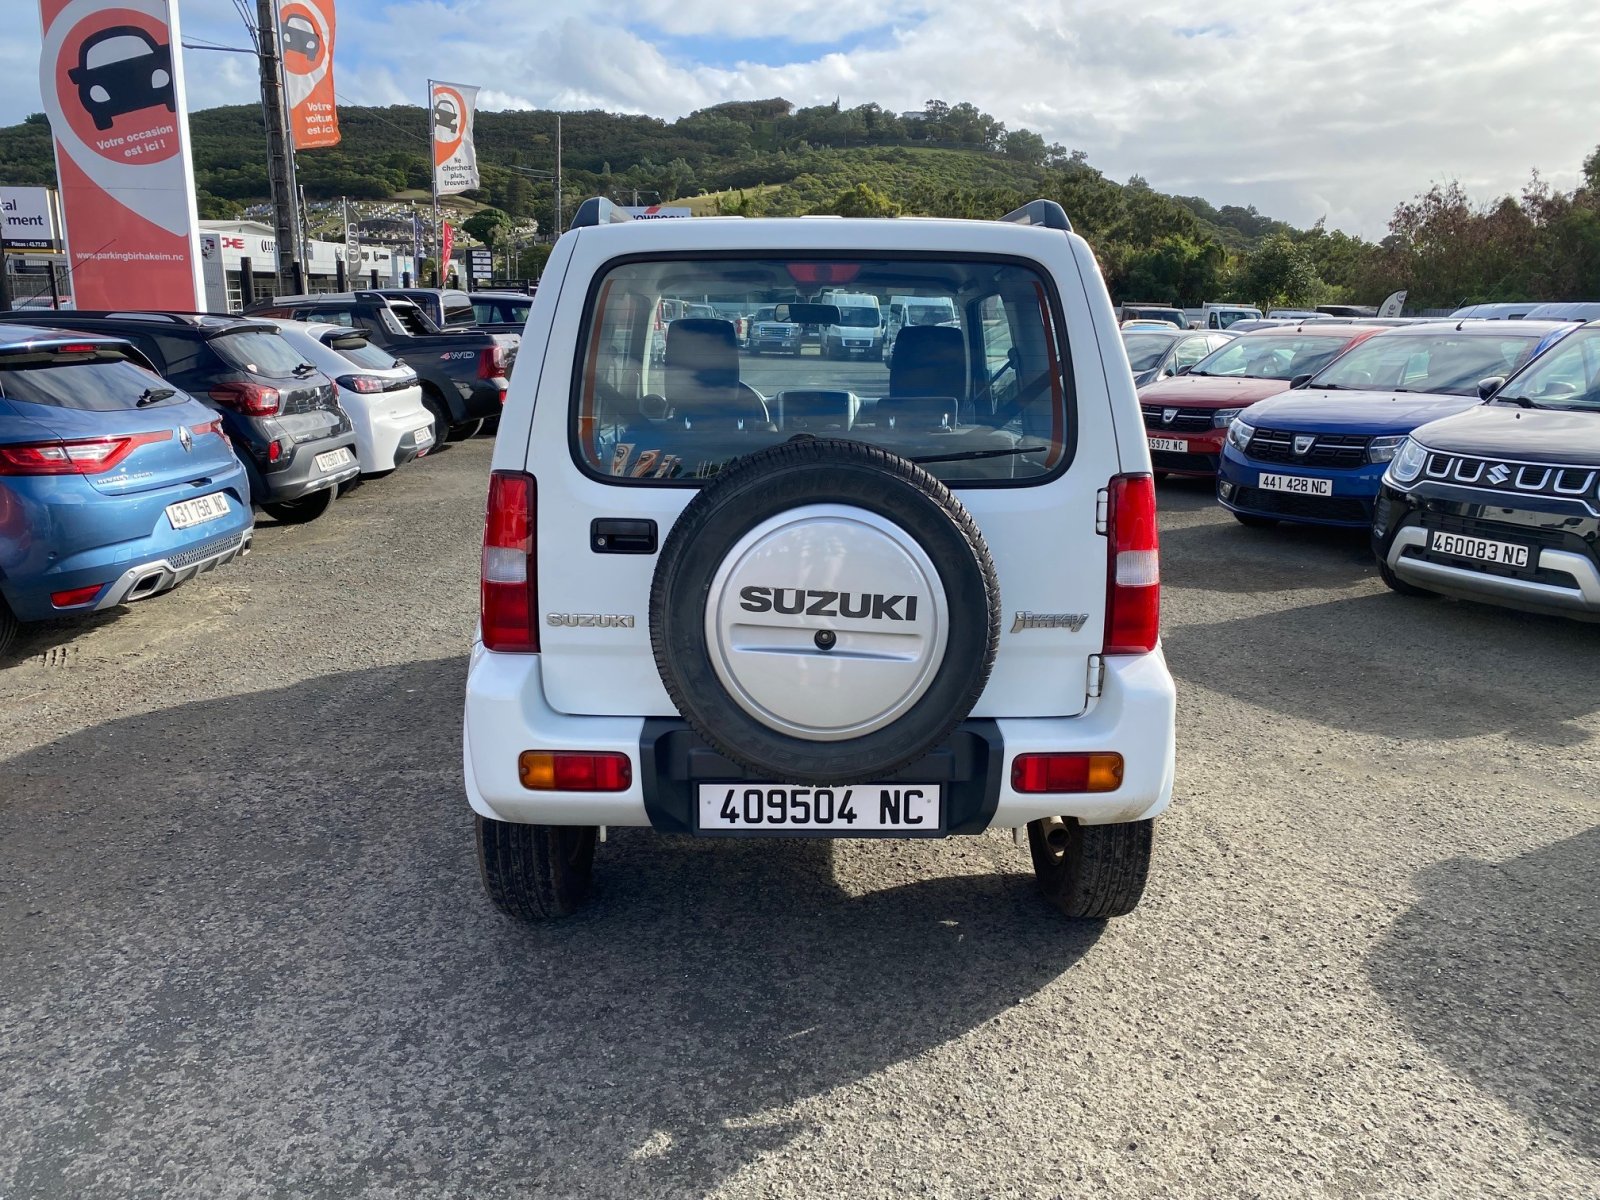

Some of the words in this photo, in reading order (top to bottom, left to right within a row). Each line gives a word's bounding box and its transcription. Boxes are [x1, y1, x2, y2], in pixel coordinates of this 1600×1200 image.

[307, 102, 332, 111] Votre
[307, 126, 321, 135] est
[322, 124, 334, 133] ici
[96, 137, 125, 150] Votre
[126, 125, 173, 142] occasion
[124, 145, 143, 157] est
[144, 140, 160, 152] ici
[2, 199, 17, 211] al
[6, 215, 44, 225] ment
[76, 252, 184, 261] www.parkingbirhakeim.nc
[440, 351, 475, 360] 4WD
[1173, 441, 1183, 451] NC
[1312, 480, 1327, 494] NC
[212, 495, 227, 512] NC
[1433, 535, 1498, 560] 460083
[1502, 545, 1527, 566] NC
[740, 585, 918, 622] SUZUKI
[546, 612, 635, 628] SUZUKI
[720, 789, 858, 824] 409504
[879, 789, 924, 825] NC
